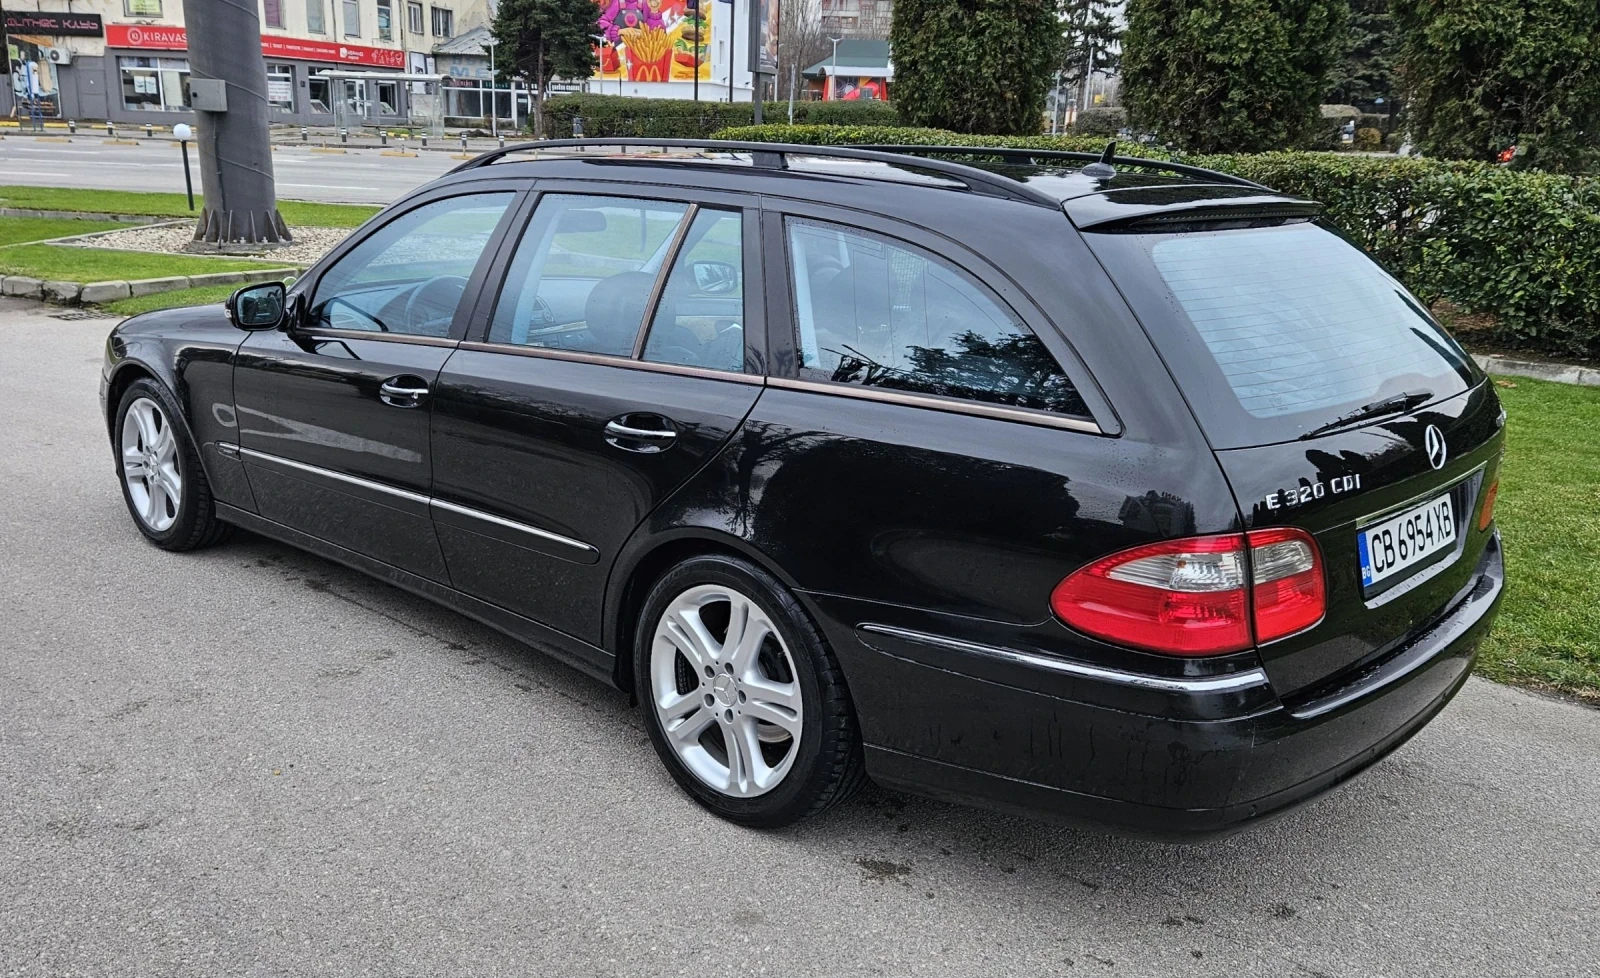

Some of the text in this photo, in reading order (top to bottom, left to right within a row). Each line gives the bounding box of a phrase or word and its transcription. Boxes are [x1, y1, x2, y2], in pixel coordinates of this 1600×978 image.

[143, 31, 187, 43] KIRAVAS
[1265, 473, 1361, 510] E 320 CDI
[1371, 501, 1452, 574] CB 6954 XB
[1361, 565, 1371, 580] BG
